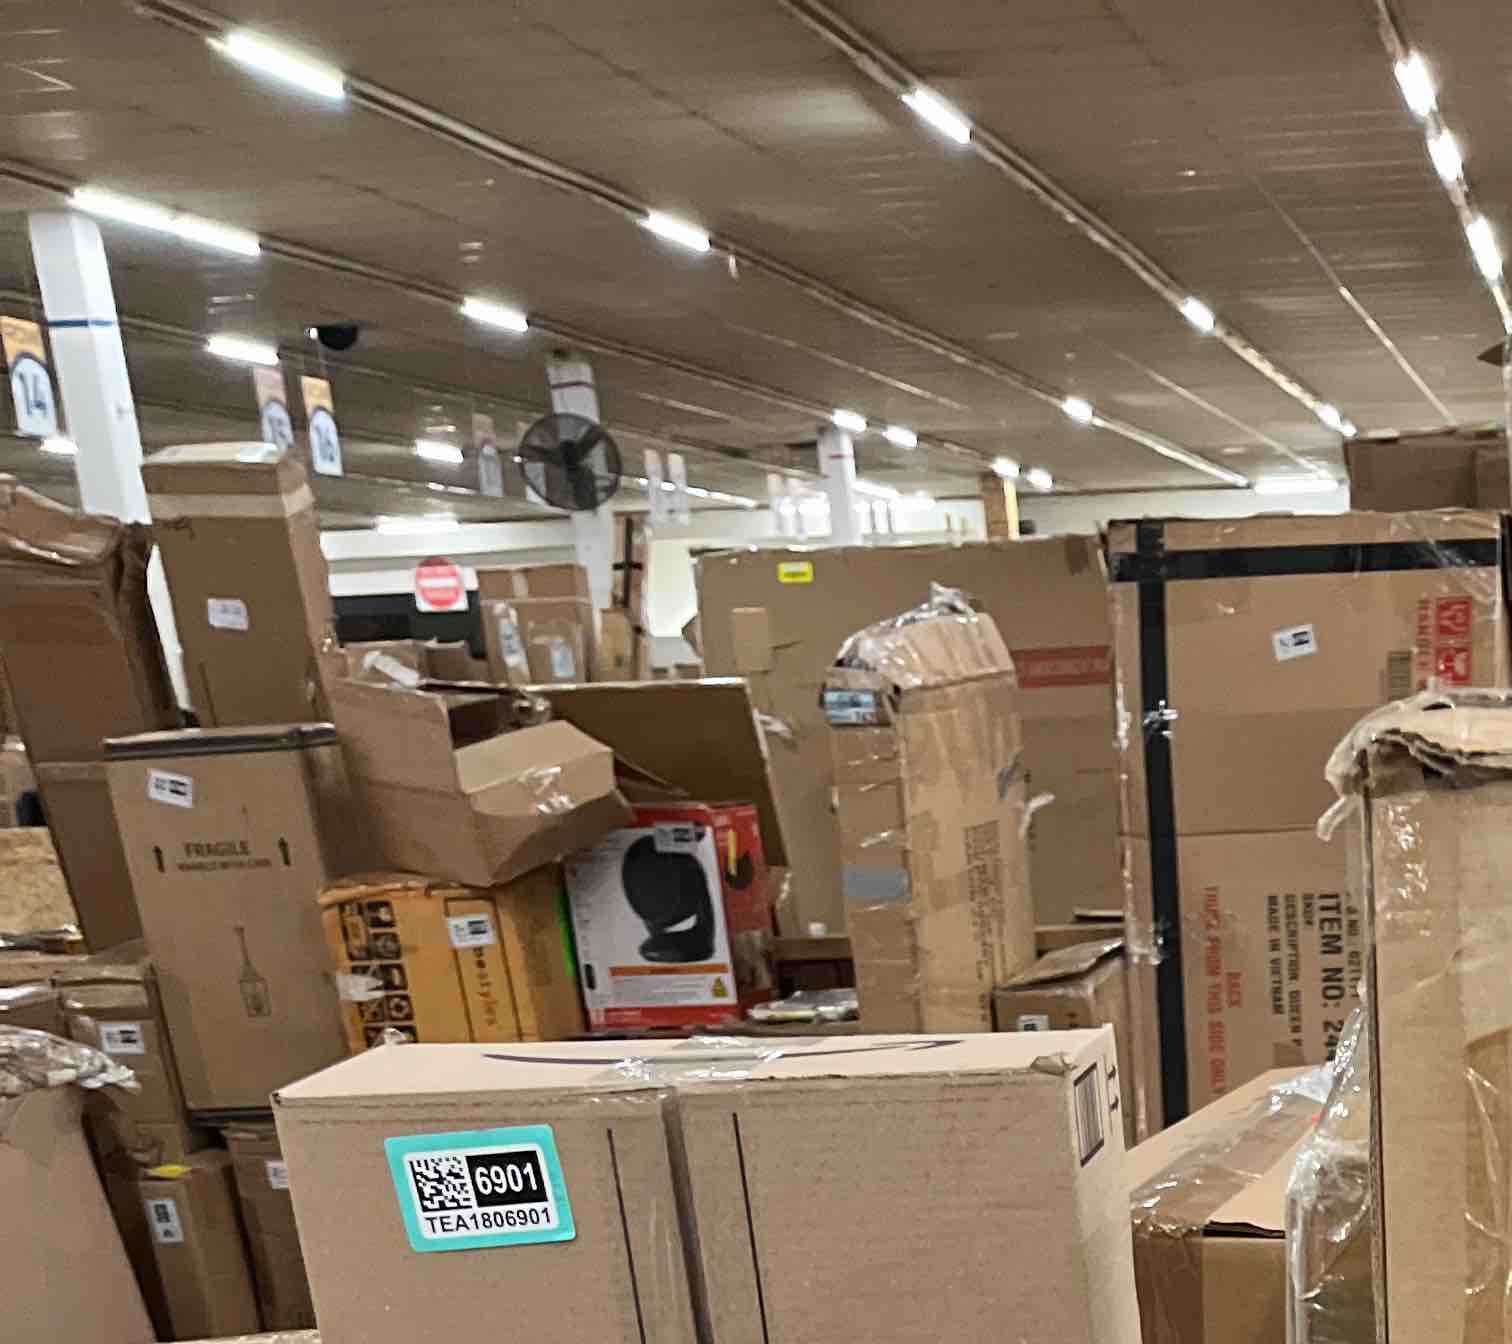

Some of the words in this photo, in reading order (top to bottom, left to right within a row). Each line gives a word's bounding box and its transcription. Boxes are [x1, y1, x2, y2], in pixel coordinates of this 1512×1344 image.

[1318, 893, 1343, 955] ITEM
[1320, 966, 1345, 1009] NO:
[474, 1162, 540, 1194] 6901
[425, 1208, 552, 1234] TEA1806901
